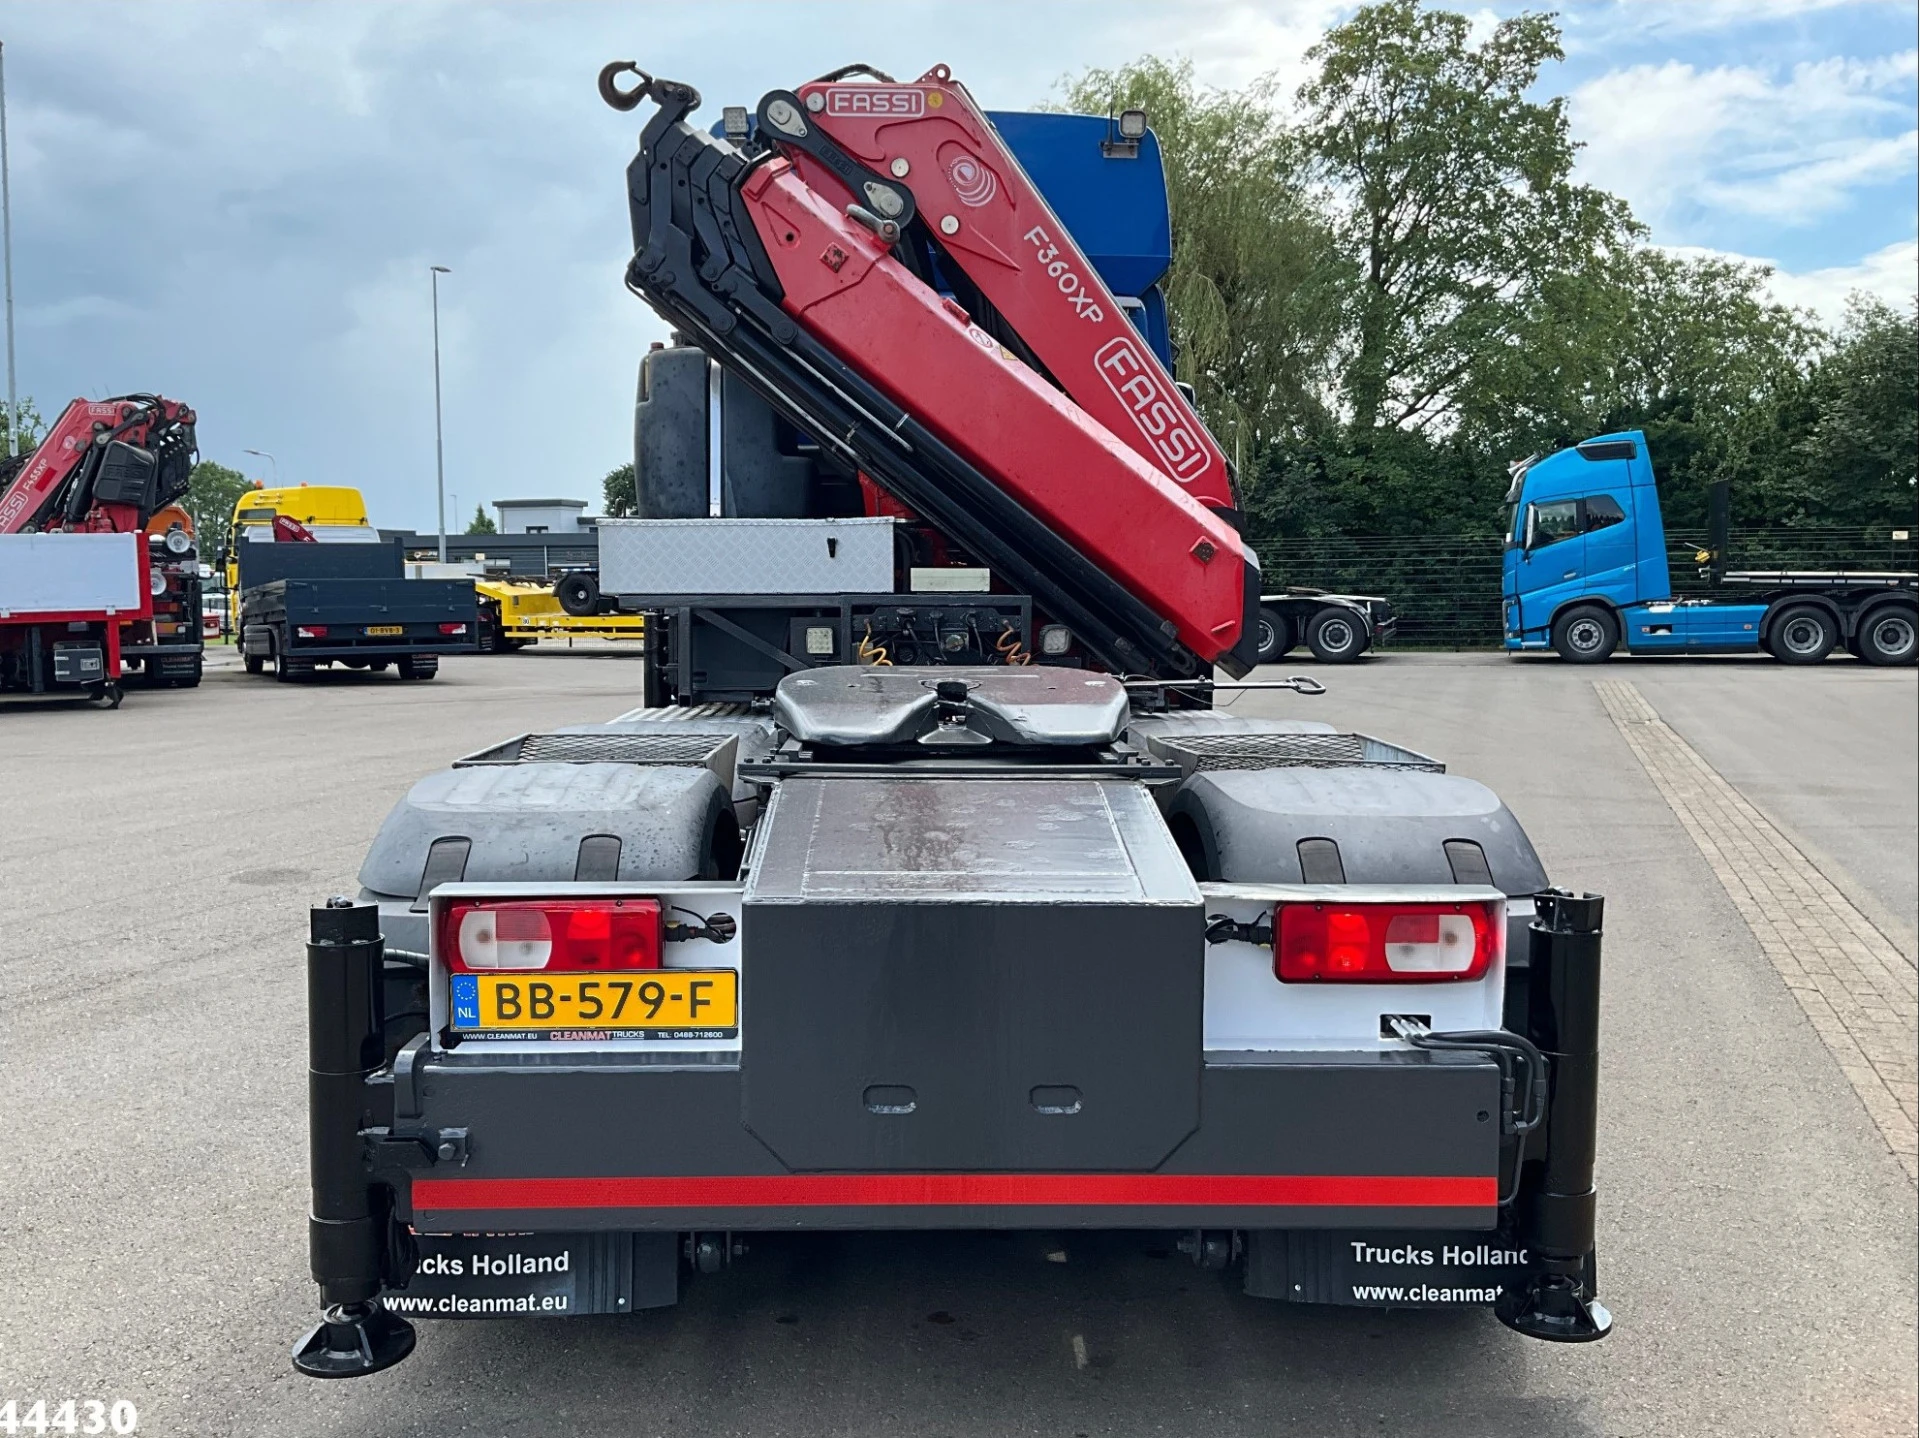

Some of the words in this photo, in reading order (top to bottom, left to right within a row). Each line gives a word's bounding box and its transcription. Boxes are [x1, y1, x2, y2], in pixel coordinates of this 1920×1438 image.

[834, 93, 916, 112] FASSI
[1023, 225, 1104, 323] F360XP
[1103, 348, 1202, 472] FASSI
[458, 1007, 476, 1018] NL
[496, 981, 713, 1020] BB-579-F
[473, 1251, 569, 1275] Holland
[1351, 1242, 1434, 1266] Trucks
[383, 1294, 568, 1313] www.cleanmat.eu
